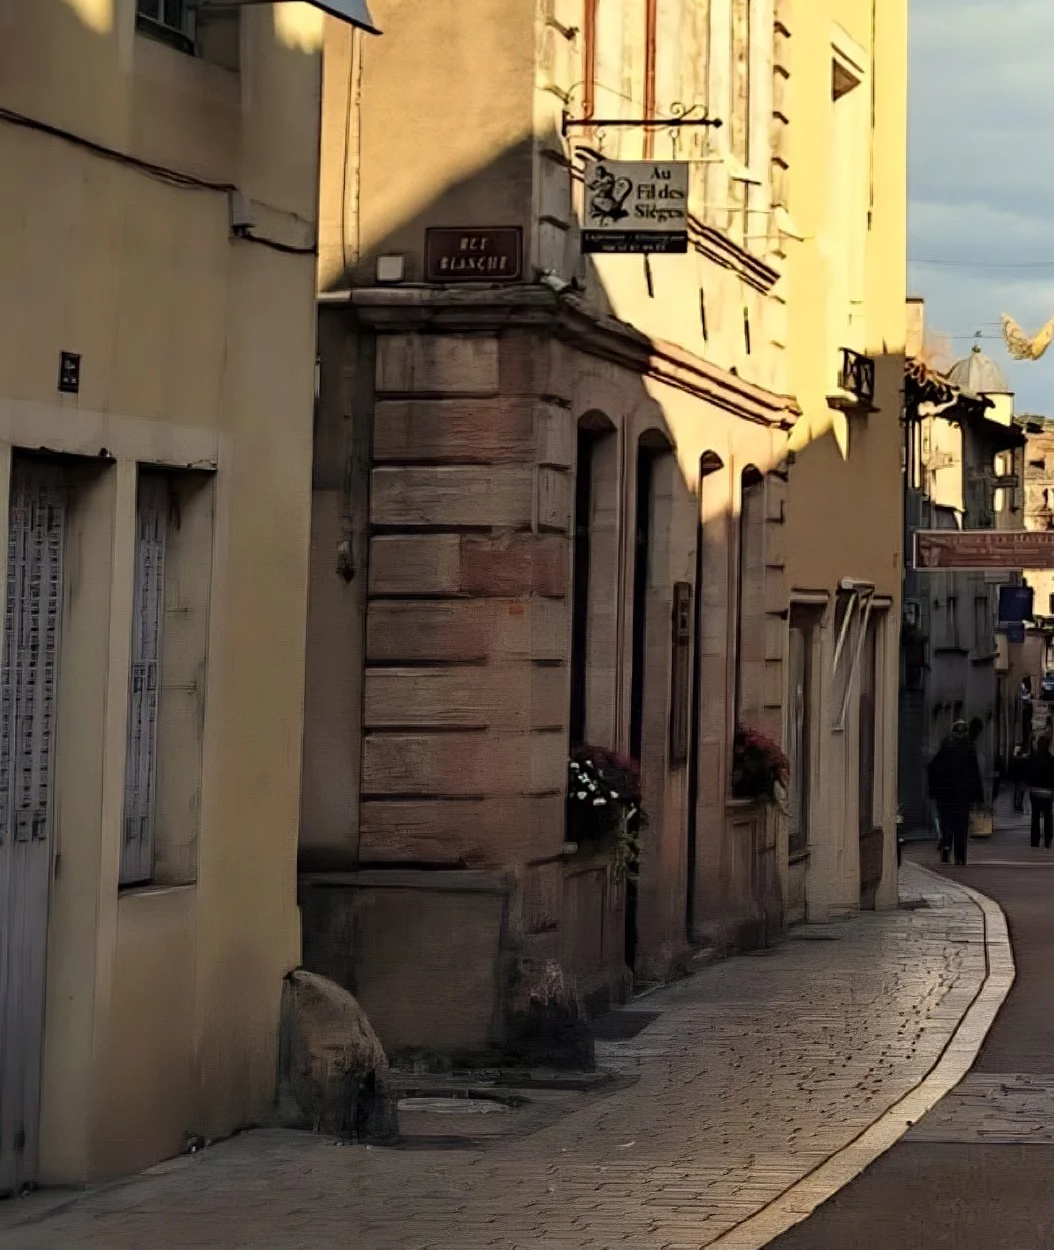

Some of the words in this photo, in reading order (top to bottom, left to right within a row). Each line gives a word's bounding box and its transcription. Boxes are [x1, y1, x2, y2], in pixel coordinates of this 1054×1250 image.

[650, 166, 671, 180] Au
[636, 183, 656, 200] Fil
[658, 183, 685, 200] des
